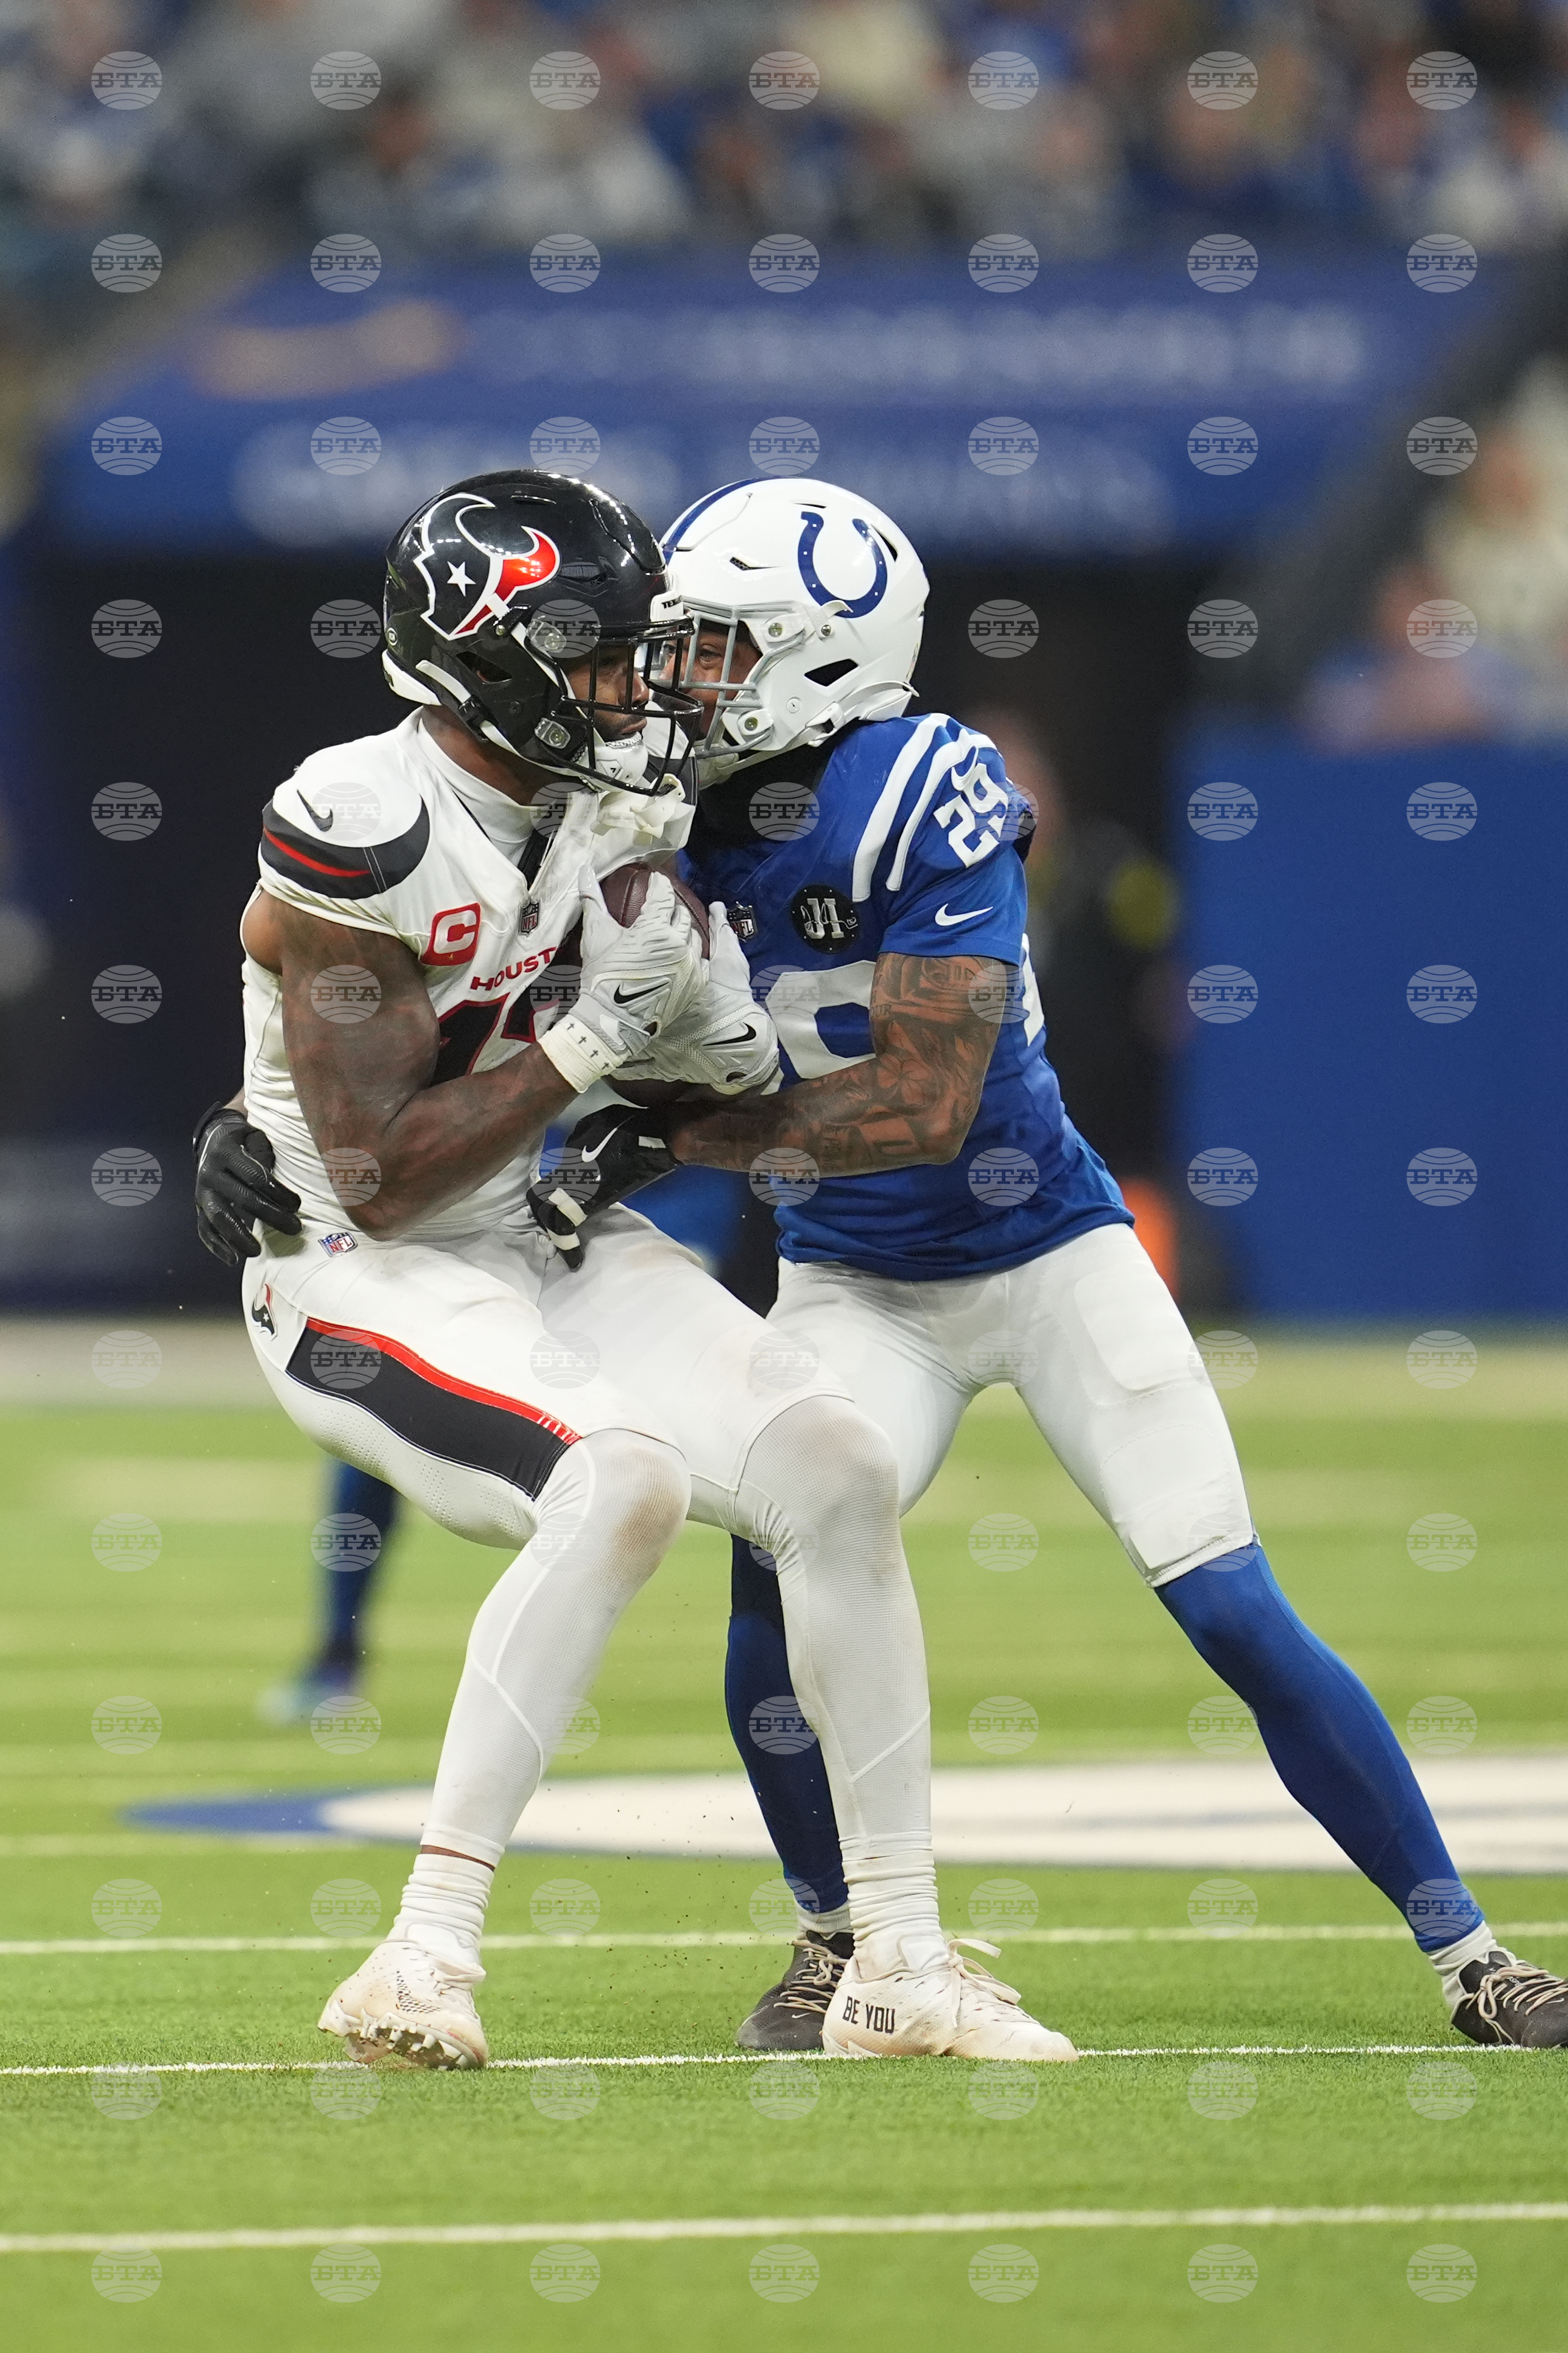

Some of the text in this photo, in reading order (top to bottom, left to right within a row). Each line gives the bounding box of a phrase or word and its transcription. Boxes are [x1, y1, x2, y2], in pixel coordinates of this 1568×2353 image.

[933, 763, 1009, 869] 29
[433, 909, 477, 954] C
[469, 946, 557, 991] HOUST
[842, 1995, 895, 2033] BE YOU
